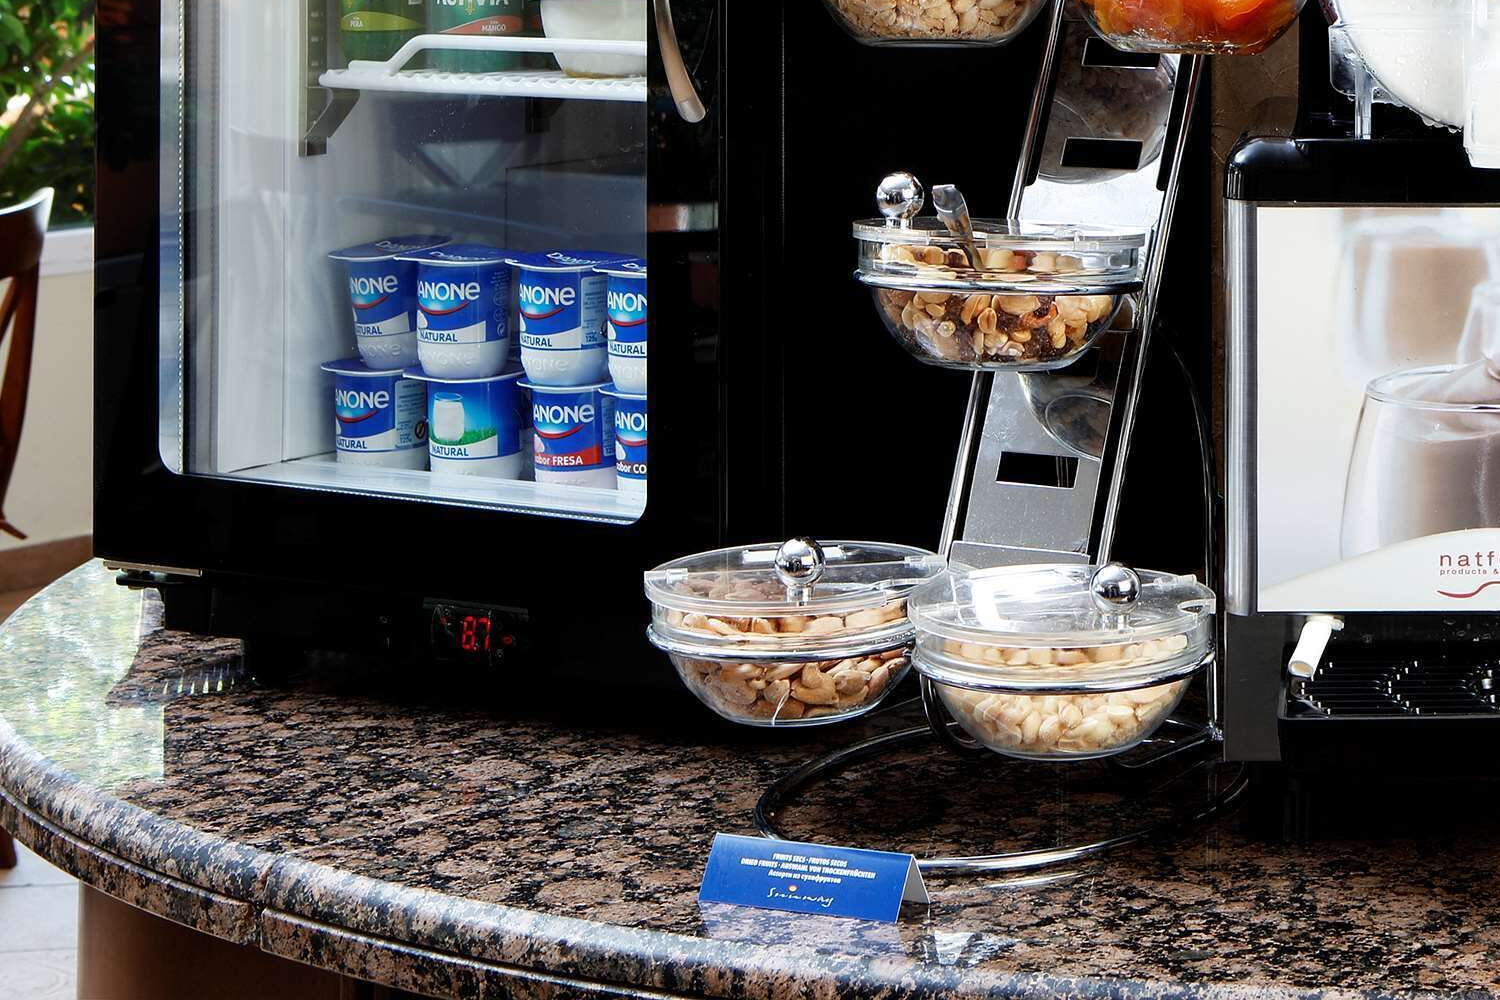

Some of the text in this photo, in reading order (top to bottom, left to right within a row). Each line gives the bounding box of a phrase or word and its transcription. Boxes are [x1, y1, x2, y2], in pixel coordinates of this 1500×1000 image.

[609, 343, 646, 355] NATURAL
[552, 455, 584, 466] FRESA
[1439, 568, 1487, 576] products
[758, 859, 778, 868] FRUITS
[772, 852, 793, 862] FRUITS
[808, 856, 830, 866] FRUTOS
[830, 859, 848, 868] SECOS
